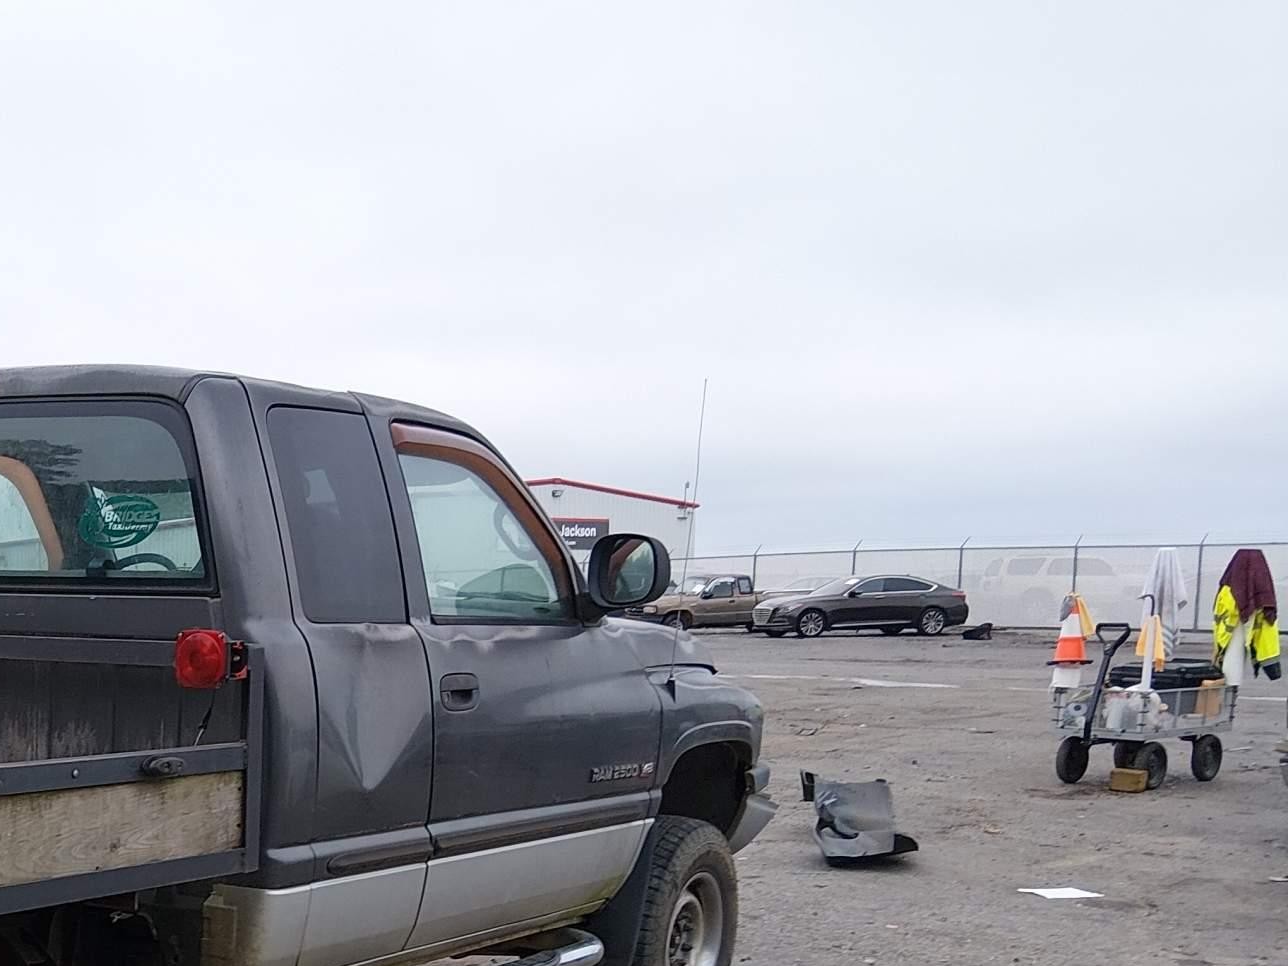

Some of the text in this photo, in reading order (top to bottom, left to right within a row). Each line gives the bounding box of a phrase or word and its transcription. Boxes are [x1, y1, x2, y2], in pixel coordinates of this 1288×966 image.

[559, 524, 597, 537] Jackson
[591, 766, 613, 783] RAM
[614, 763, 639, 779] 2500
